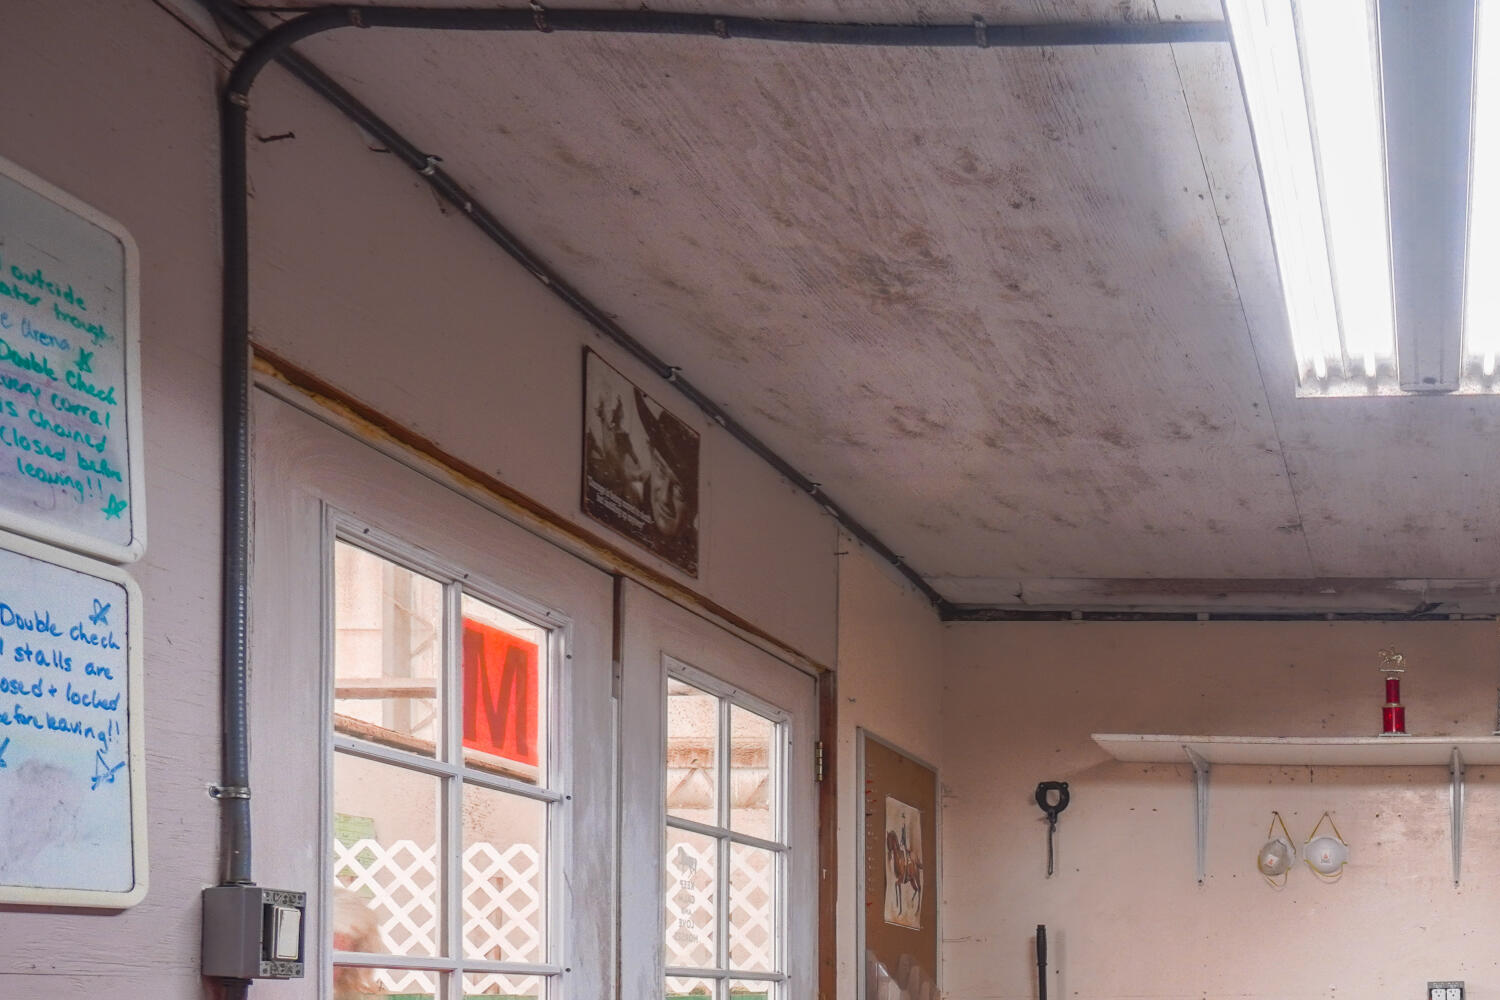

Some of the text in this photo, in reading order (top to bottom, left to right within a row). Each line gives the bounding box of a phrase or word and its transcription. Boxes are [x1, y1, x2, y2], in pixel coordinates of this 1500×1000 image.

[11, 264, 87, 311] outside
[0, 603, 63, 639] Double
[14, 644, 114, 681] stalls are
[66, 683, 121, 712] locked
[45, 712, 120, 753] leaving!!
